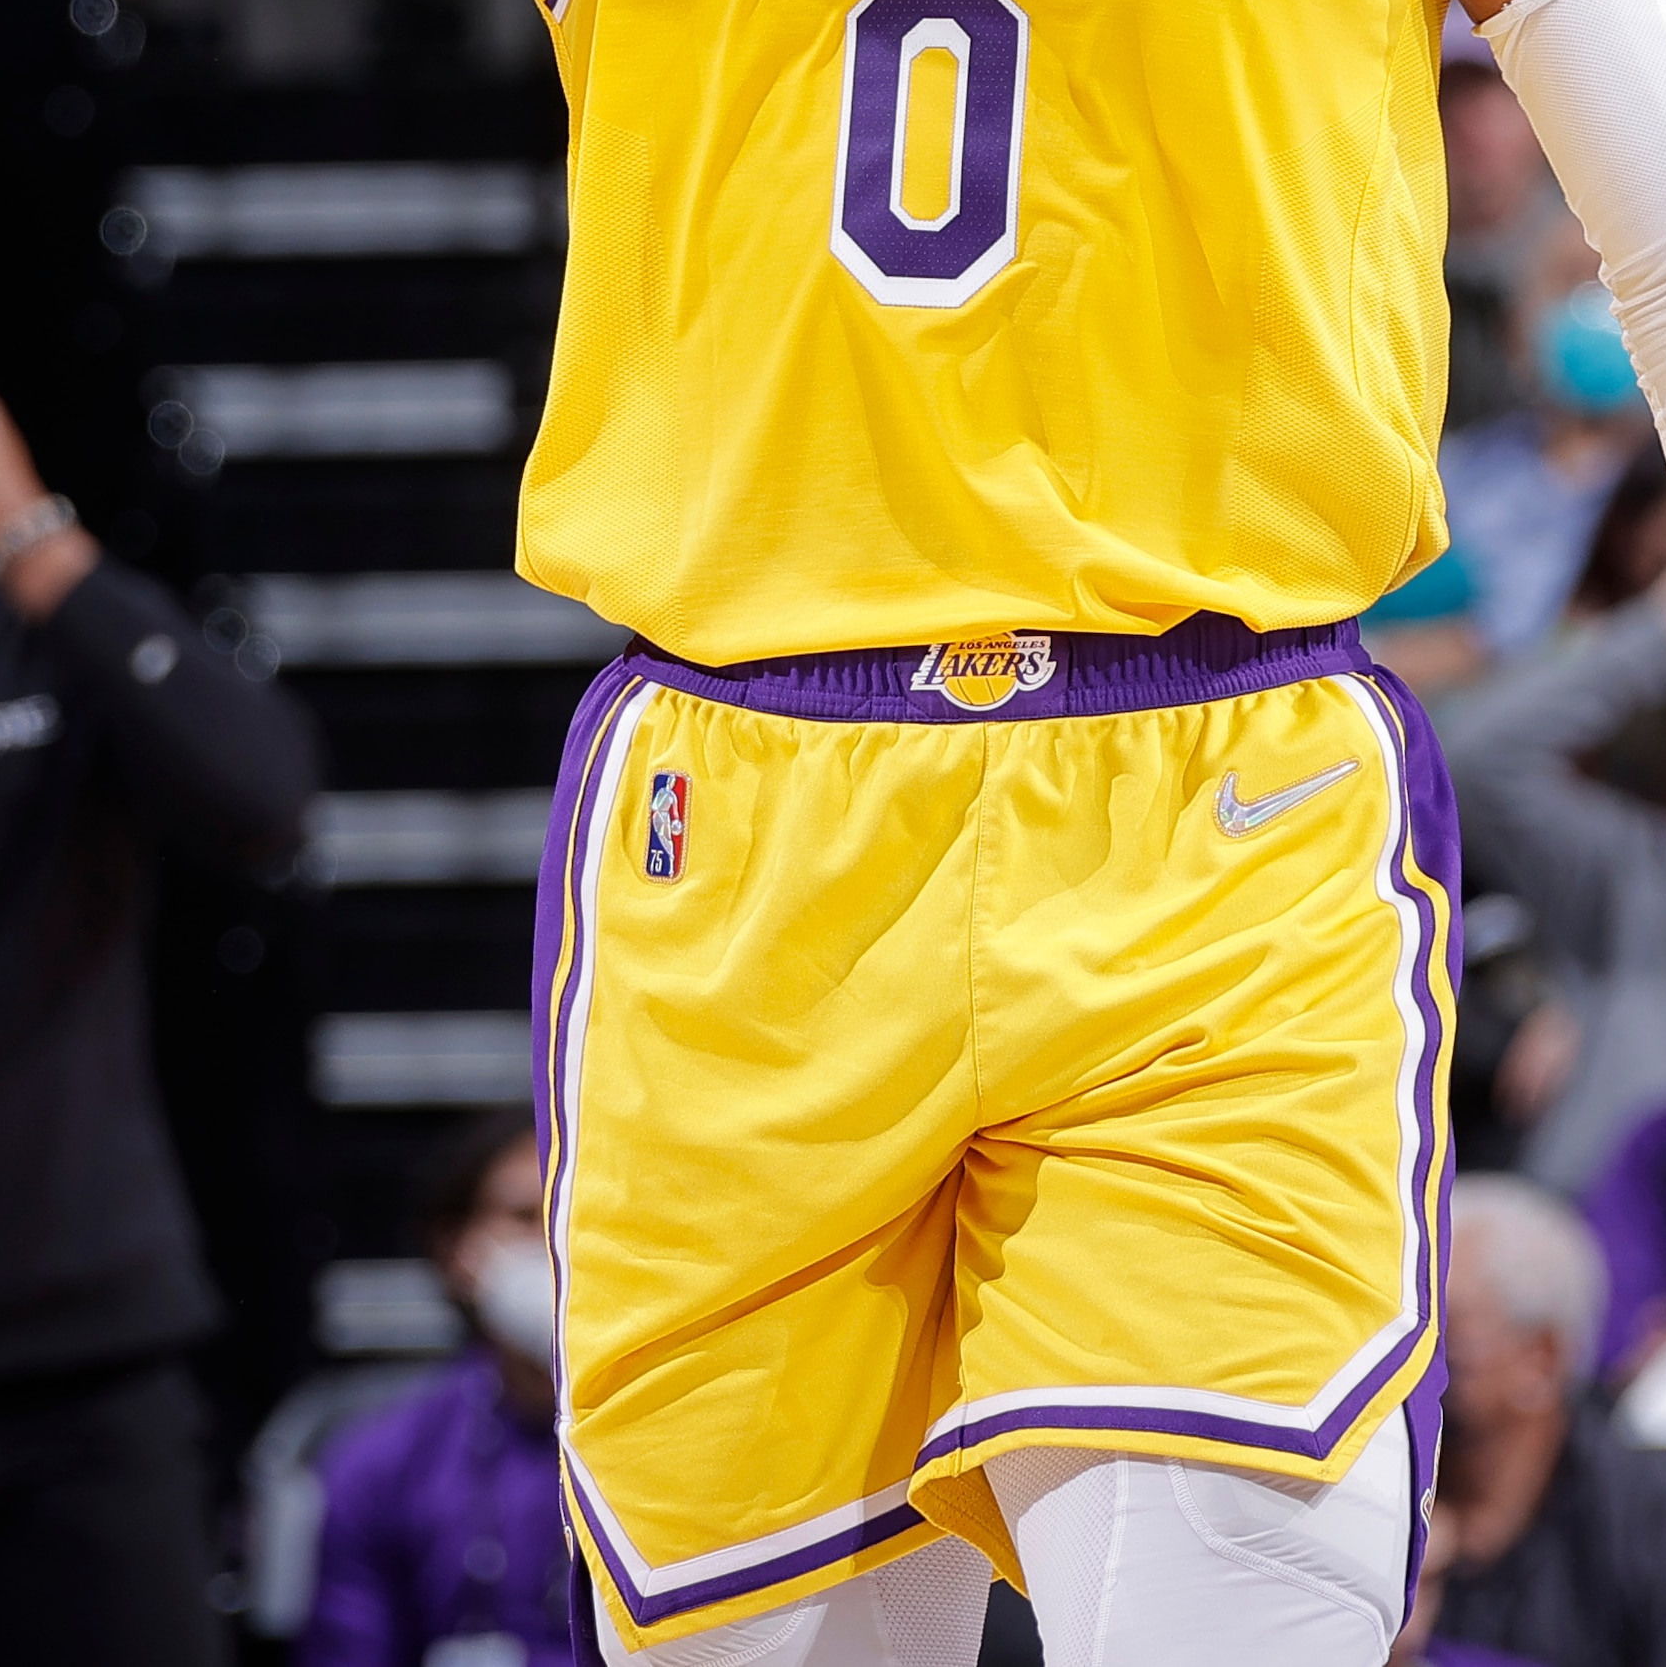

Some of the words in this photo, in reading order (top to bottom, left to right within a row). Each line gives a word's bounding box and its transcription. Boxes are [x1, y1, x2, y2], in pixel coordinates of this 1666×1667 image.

[958, 640, 983, 650] LOS
[983, 639, 1046, 650] ANGELES
[913, 642, 1052, 685] LAKERS
[650, 849, 664, 875] 75
